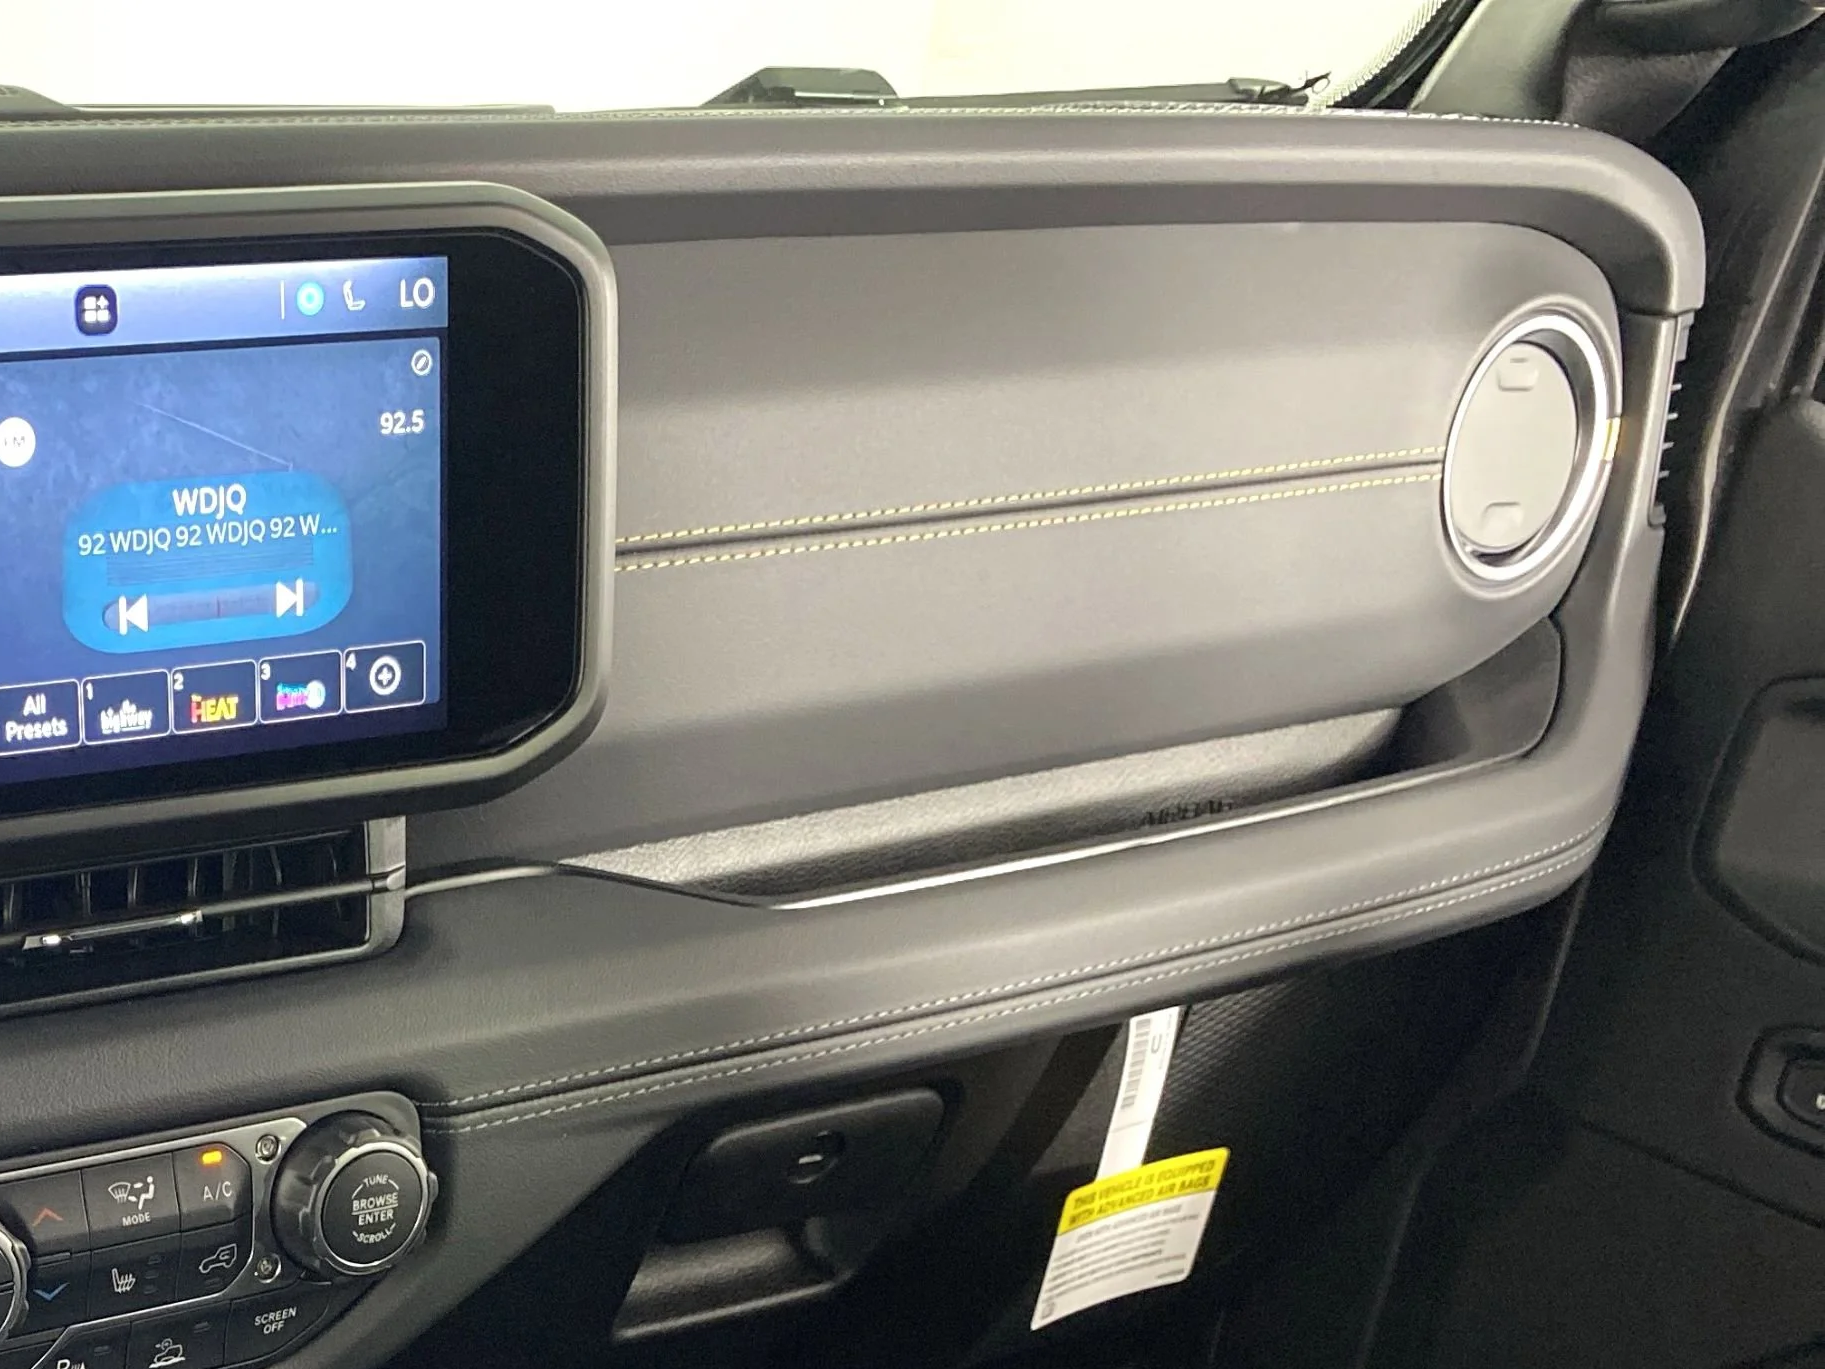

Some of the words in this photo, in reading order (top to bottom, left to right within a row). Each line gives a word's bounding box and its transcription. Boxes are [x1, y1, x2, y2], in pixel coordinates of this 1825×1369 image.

[400, 278, 435, 308] LO
[380, 410, 425, 435] 92.5
[172, 483, 248, 519] WDJQ
[78, 534, 107, 556] 92
[110, 529, 172, 555] WDJQ
[175, 525, 204, 548] 92
[207, 519, 266, 547] WDJQ
[270, 516, 295, 540] 92
[345, 652, 356, 671] 4
[173, 672, 184, 691] 2
[261, 663, 271, 681] 3
[86, 682, 94, 700] 1
[23, 693, 47, 715] All
[191, 696, 239, 724] HEAT
[5, 716, 68, 742] Presets
[363, 1173, 389, 1188] TUNE
[202, 1180, 234, 1202] A/C
[352, 1192, 398, 1211] BROWSE
[121, 1212, 151, 1227] MODE
[358, 1209, 394, 1226] ENTER
[357, 1228, 393, 1244] SCROLL
[253, 1306, 297, 1329] SCREEN
[263, 1318, 286, 1336] OFF
